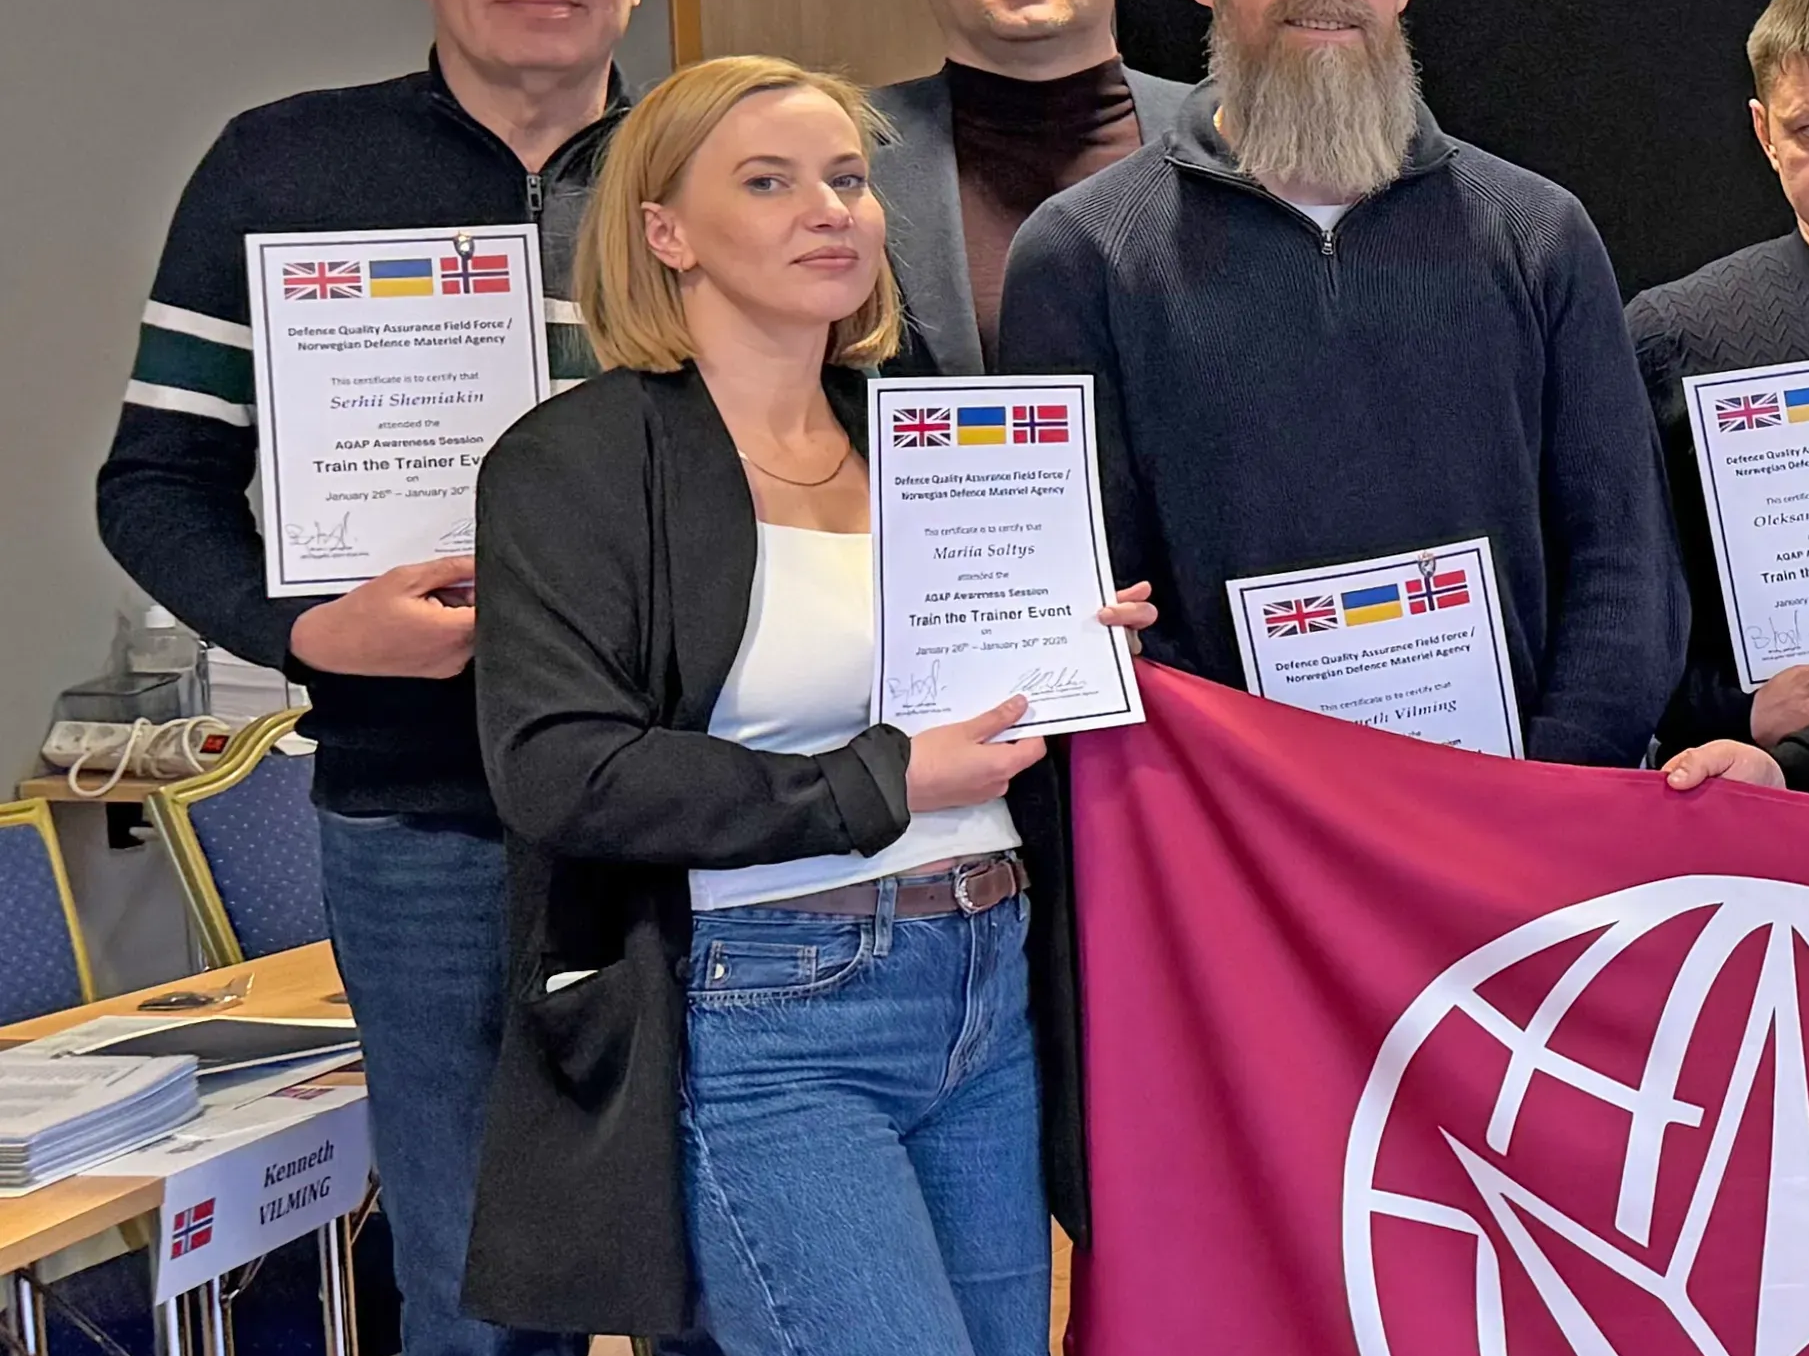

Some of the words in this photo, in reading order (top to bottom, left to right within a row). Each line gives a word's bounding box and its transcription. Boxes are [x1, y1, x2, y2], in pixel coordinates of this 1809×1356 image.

[287, 326, 336, 336] Defence
[337, 324, 380, 335] Quality
[382, 323, 441, 333] Assurance
[443, 319, 471, 330] Field
[472, 319, 504, 329] Force
[297, 340, 361, 351] Norwegian
[363, 337, 411, 349] Defence
[413, 334, 462, 346] Materiel
[464, 334, 505, 346] Agency
[312, 459, 357, 473] Train
[362, 458, 389, 471] the
[393, 455, 455, 469] Trainer
[1759, 569, 1796, 583] Train
[908, 612, 941, 627] Train
[944, 611, 966, 624] the
[969, 609, 1022, 622] Trainer
[1027, 604, 1071, 618] Event
[1274, 658, 1319, 671] Defence
[1320, 652, 1358, 665] Quality
[1360, 642, 1413, 658] Assurance
[1414, 634, 1440, 647] Field
[1440, 630, 1468, 642] Force
[1285, 668, 1343, 683] Norwegian
[1344, 660, 1387, 674] Defence
[1389, 649, 1433, 666] Materiel
[1435, 643, 1470, 657] Agency
[1353, 711, 1388, 727] neth
[264, 1139, 334, 1189] Kenneth
[260, 1175, 332, 1225] VILMING
